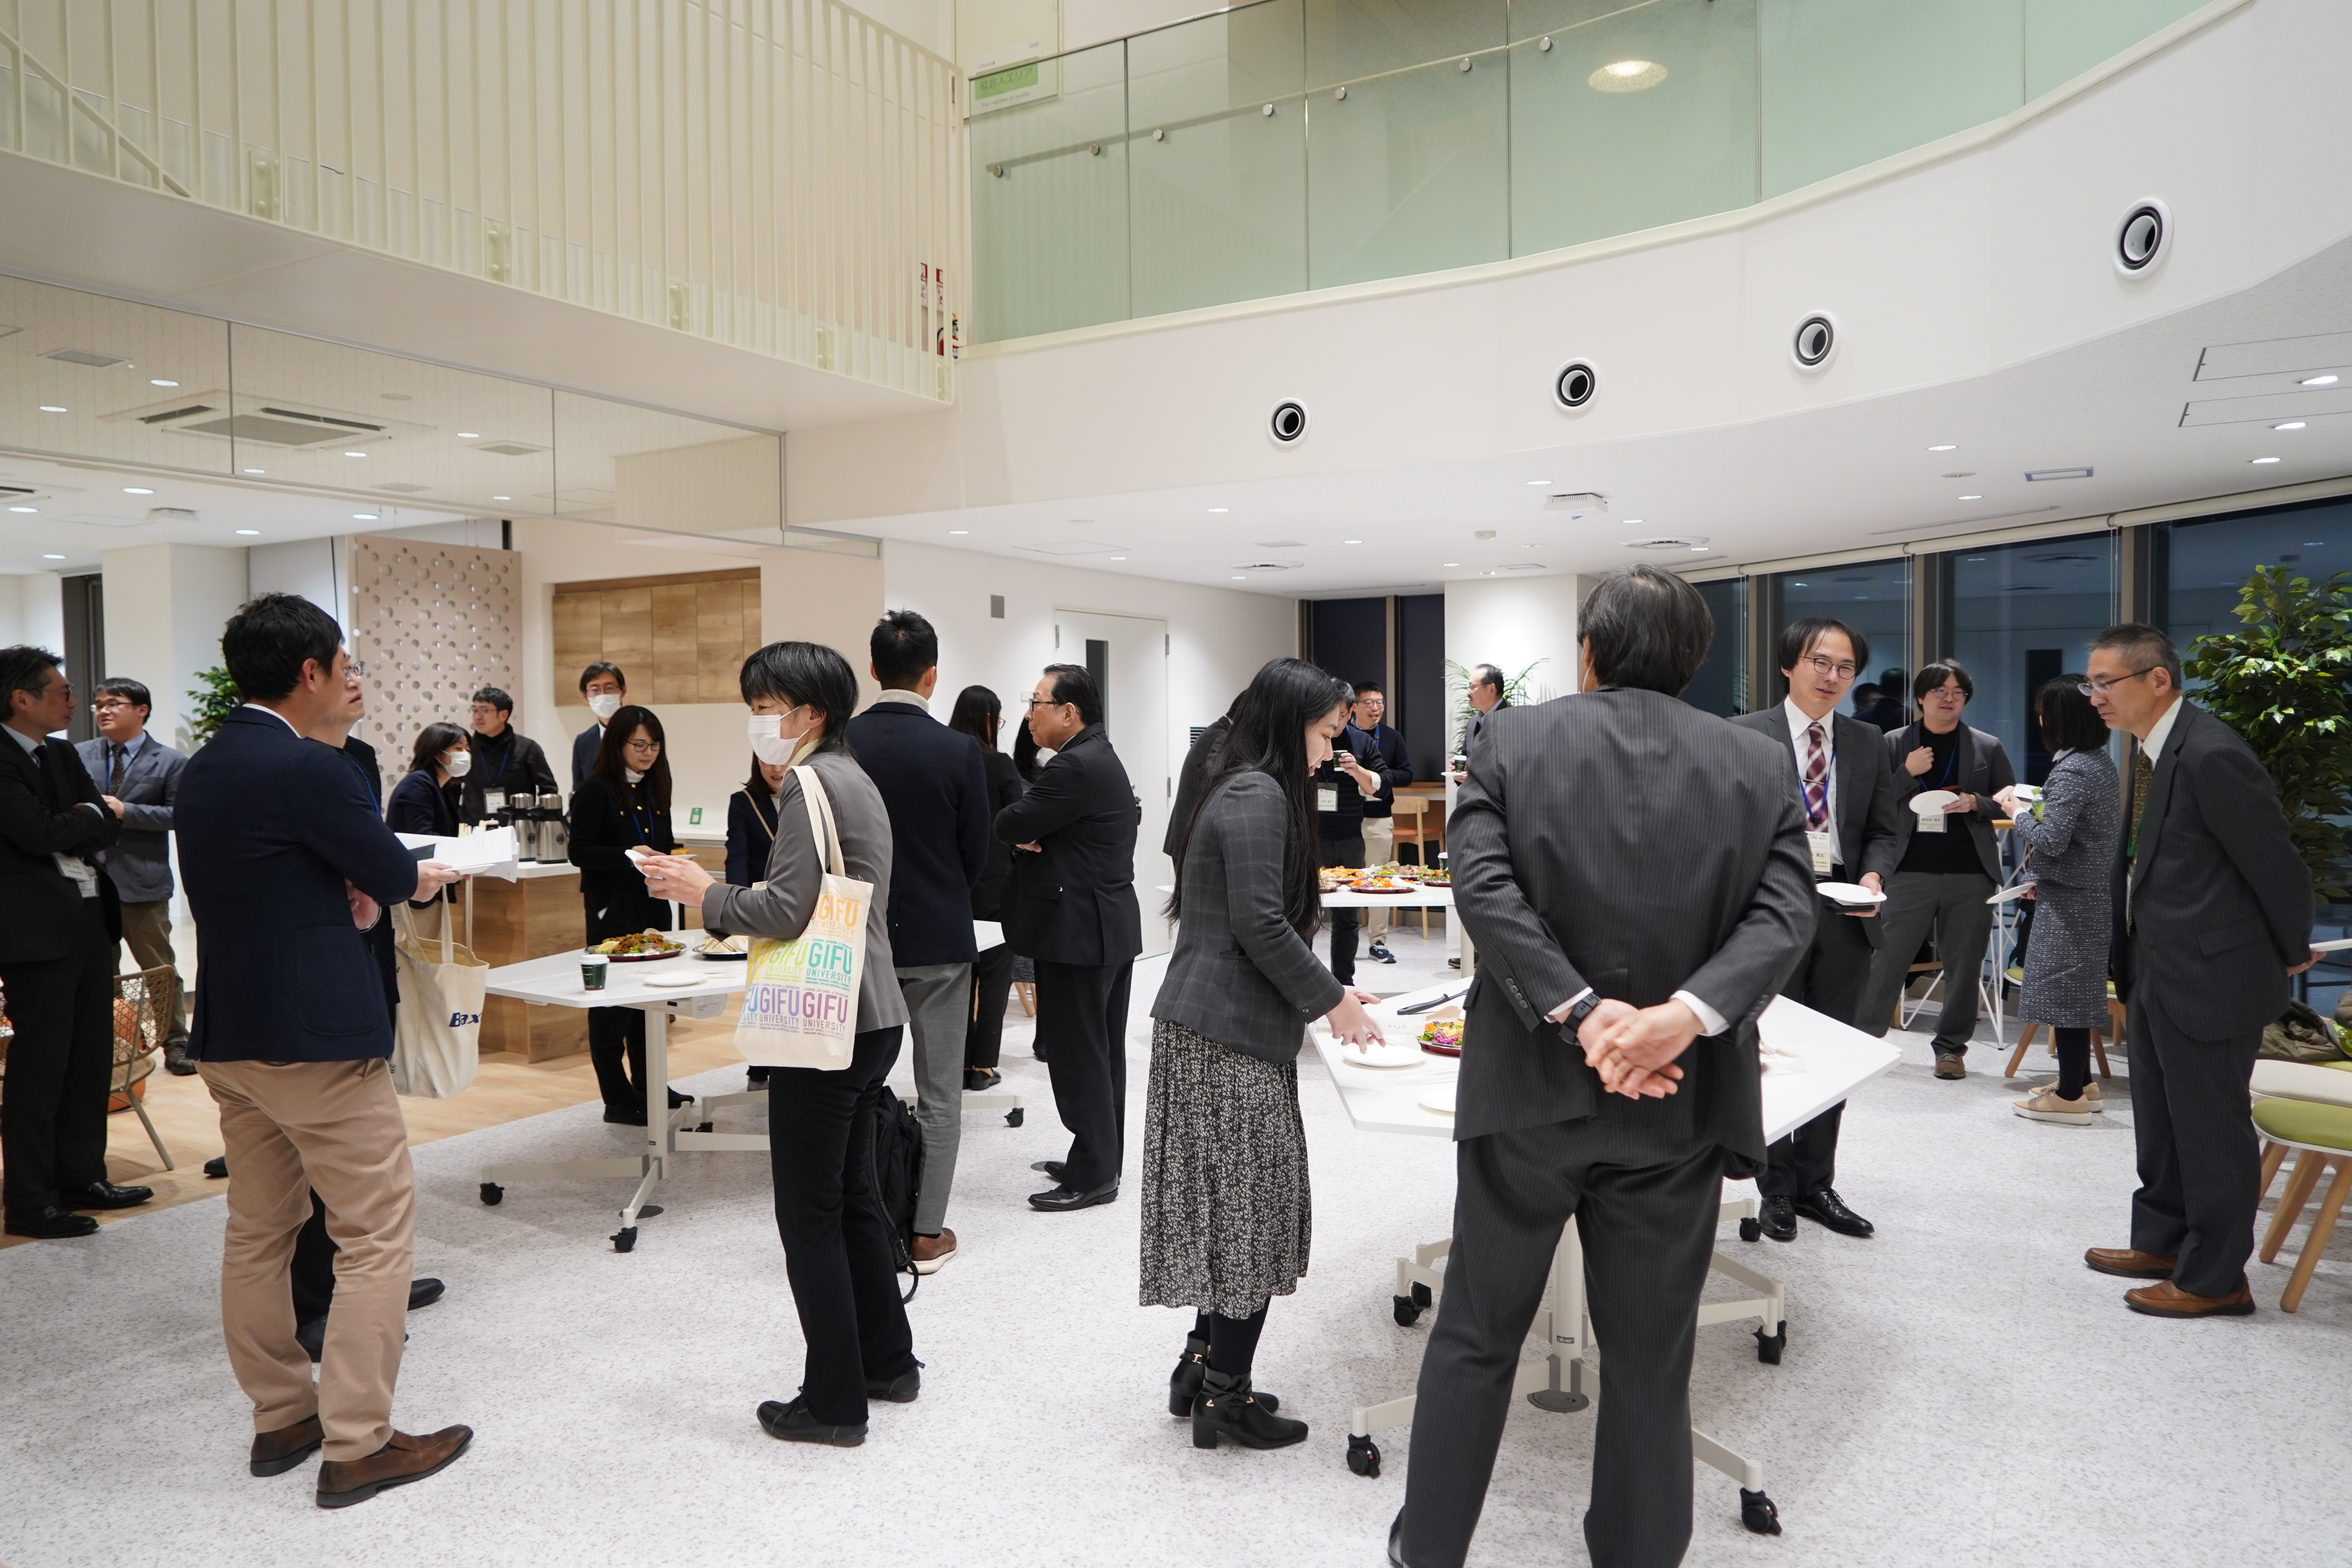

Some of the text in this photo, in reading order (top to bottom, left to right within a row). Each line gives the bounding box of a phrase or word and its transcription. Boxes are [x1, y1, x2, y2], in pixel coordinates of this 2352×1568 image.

[980, 67, 1032, 89] 社会人エリア
[818, 895, 859, 927] GIFU
[815, 920, 855, 936] UNIVERSITY
[769, 942, 809, 966] GIFU
[808, 942, 852, 975] GIFU
[765, 964, 803, 975] UNIVERSITY
[806, 967, 851, 984] UNIVERSITY
[742, 987, 759, 1013] FU
[760, 987, 800, 1016] GIFU
[803, 992, 848, 1024] GIFU
[449, 1012, 482, 1027] Bax
[760, 1013, 799, 1026] UNIVERSITY
[803, 1018, 846, 1034] UNIVERSITY
